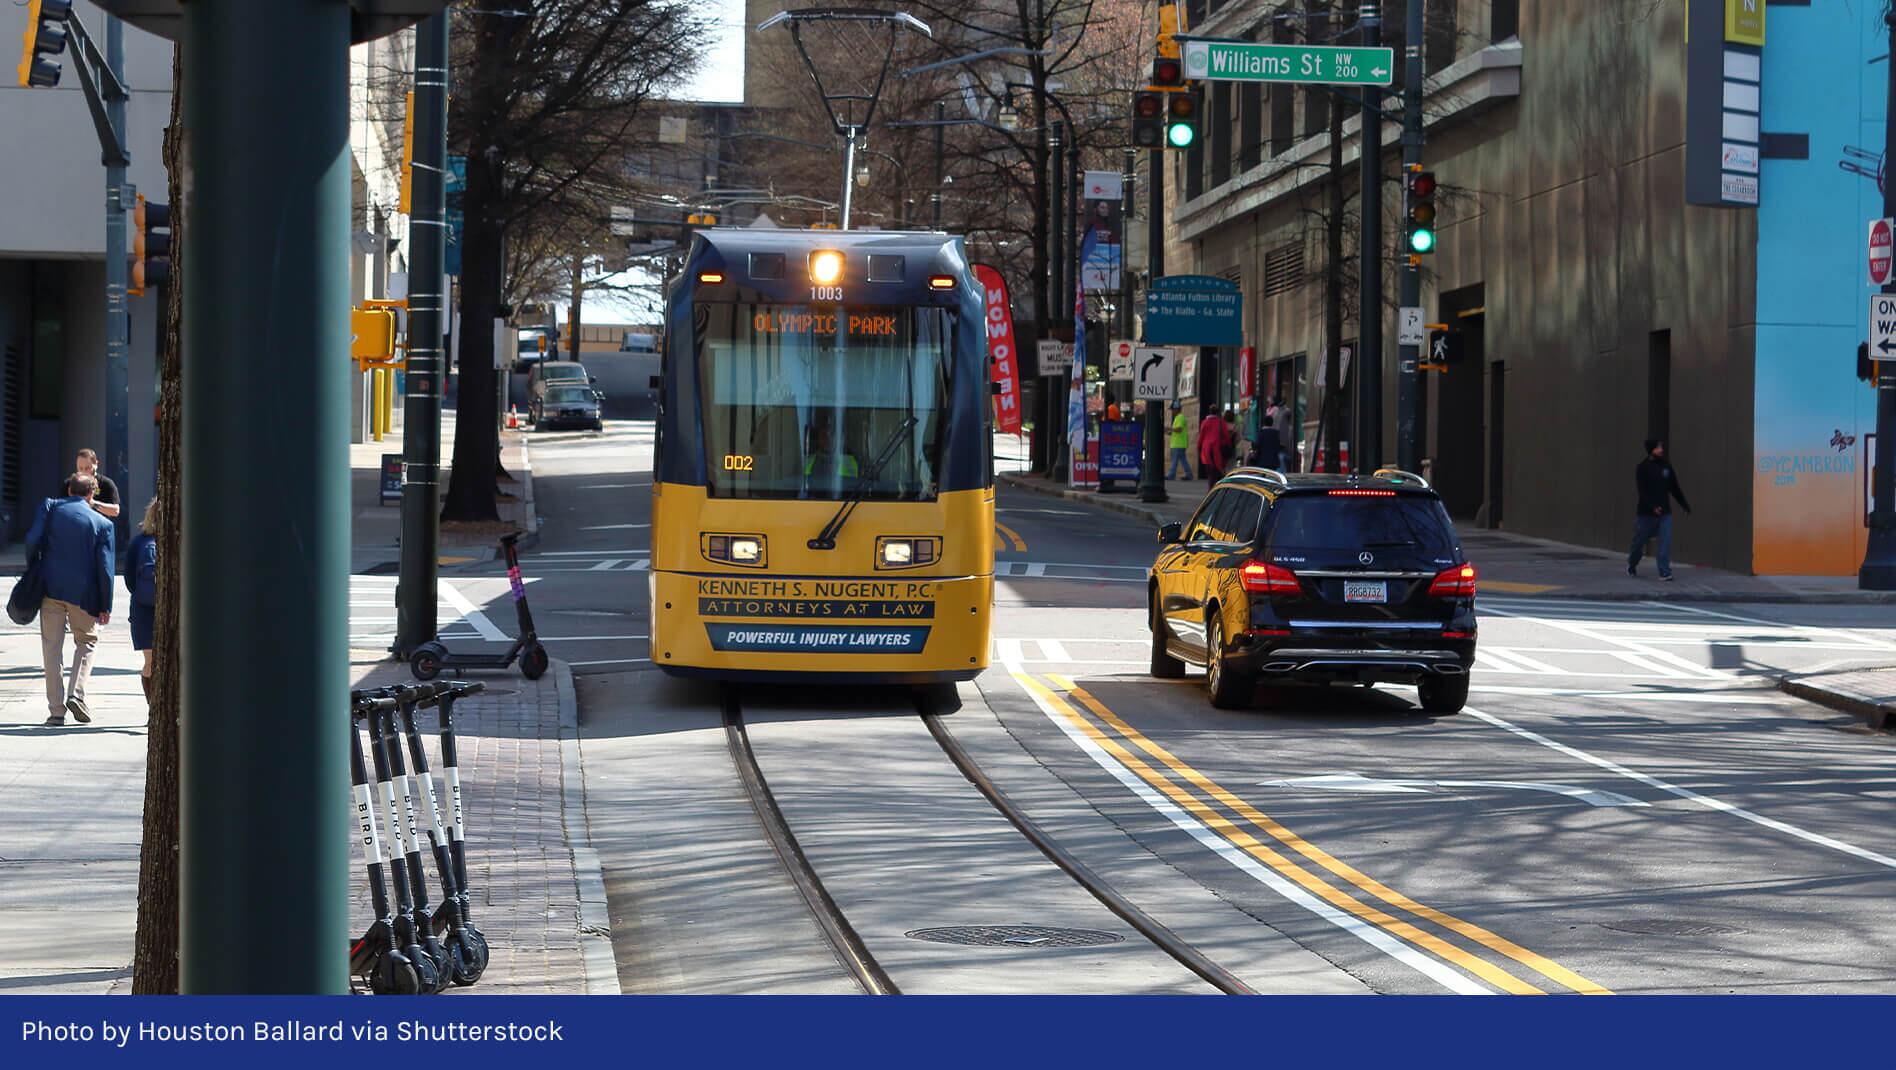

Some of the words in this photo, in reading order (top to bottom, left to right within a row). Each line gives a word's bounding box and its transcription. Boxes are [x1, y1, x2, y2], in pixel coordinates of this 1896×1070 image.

[1212, 49, 1290, 74] Williams
[1300, 53, 1323, 76] St
[1335, 53, 1352, 64] NW
[1335, 66, 1358, 77] 200
[810, 287, 843, 301] 1003
[1161, 293, 1186, 302] Atlanta
[1212, 293, 1236, 304] Library
[1161, 306, 1173, 315] The
[1216, 308, 1235, 317] State
[754, 314, 838, 334] OLYMPIC
[849, 316, 897, 335] PARK
[1138, 385, 1168, 396] ONLY
[724, 455, 753, 471] 002
[1112, 454, 1129, 465] 50
[1758, 456, 1855, 473] @YCAMBRON
[698, 580, 786, 596] KENNETH
[792, 582, 808, 596] S.
[815, 582, 899, 599] NUGENT,
[907, 583, 935, 598] P.C.
[707, 601, 832, 615] ATTORNEYS
[843, 603, 870, 615] AT
[882, 604, 925, 616] LAW
[727, 631, 796, 644] POWERFUL
[799, 632, 848, 647] INJURY
[848, 633, 912, 646] LAWYERS
[358, 802, 373, 845] BIRD
